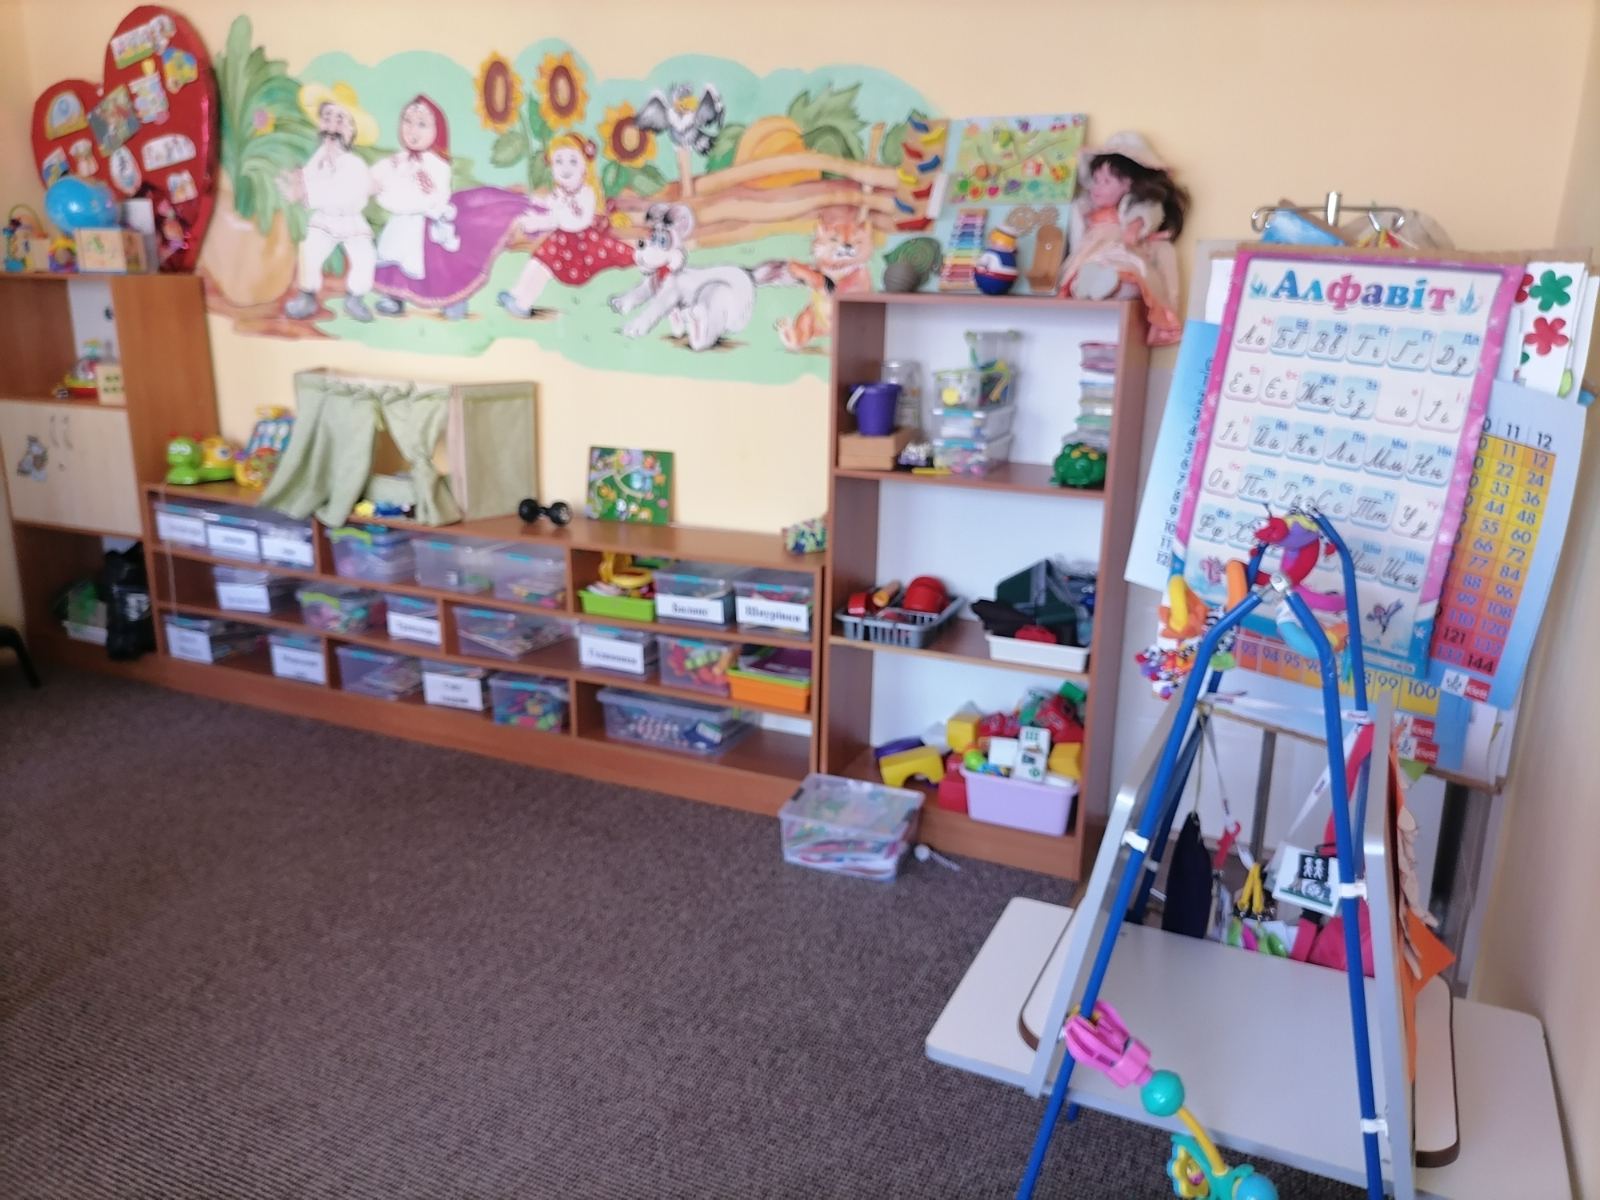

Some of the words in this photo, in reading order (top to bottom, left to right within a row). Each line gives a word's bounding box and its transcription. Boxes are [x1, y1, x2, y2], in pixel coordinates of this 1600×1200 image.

[1270, 270, 1455, 311] Алфавіт
[1507, 424, 1520, 440] 11
[1537, 433, 1552, 449] 12
[1503, 444, 1516, 458] 11
[1533, 453, 1549, 468] 12
[1496, 462, 1514, 478] 22
[1527, 471, 1545, 487] 24
[1490, 481, 1509, 497] 33
[1521, 491, 1540, 507] 36
[1485, 501, 1504, 515] 44
[1517, 510, 1536, 526] 48
[1480, 519, 1498, 535] 55
[1511, 529, 1531, 544] 60
[1473, 538, 1493, 552] 66
[1506, 547, 1525, 563] 72
[1468, 556, 1488, 569] 77
[1500, 565, 1520, 581] 84
[1444, 626, 1466, 644] 121
[1262, 646, 1278, 661] 94
[1284, 652, 1300, 667] 95
[1378, 674, 1399, 689] 99
[1408, 681, 1437, 698] 100
[1468, 653, 1494, 672] 144
